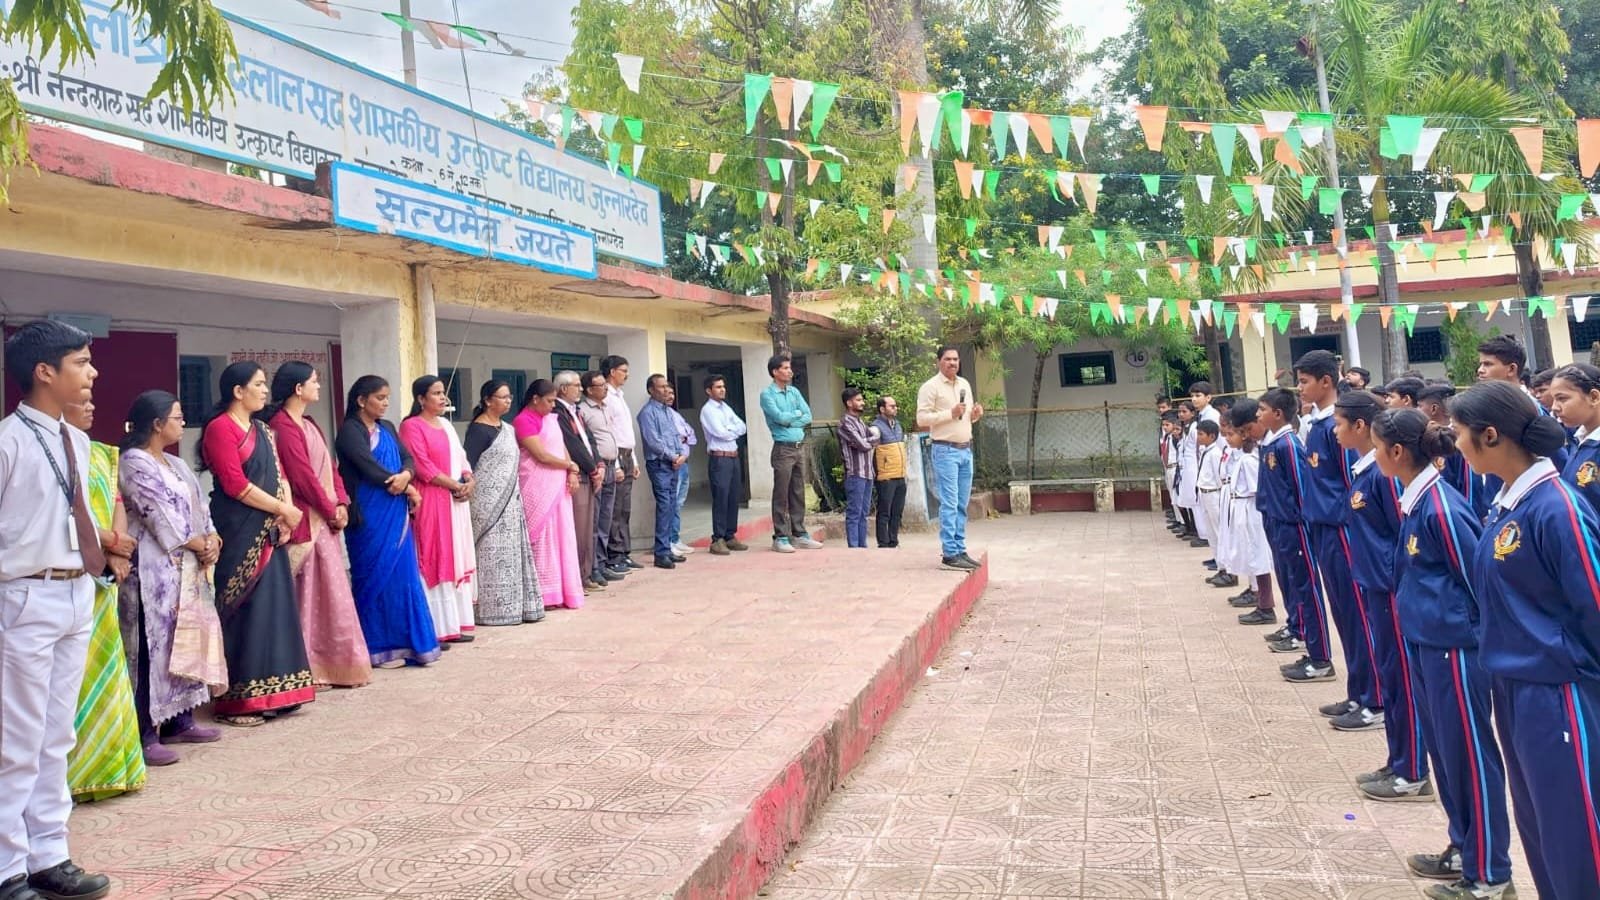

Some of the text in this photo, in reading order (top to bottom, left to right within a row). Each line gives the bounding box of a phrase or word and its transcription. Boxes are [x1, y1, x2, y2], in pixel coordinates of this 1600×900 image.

[13, 56, 41, 97] श्री
[46, 71, 122, 115] नन्दलाल
[235, 123, 284, 161] उत्कृष्ट
[306, 79, 344, 130] सूद
[348, 92, 441, 158] शासकीय
[446, 130, 513, 180] उत्कृष्ट
[515, 147, 586, 207] विद्यालय
[589, 182, 649, 226] जुन्नारदेव
[439, 168, 446, 181] 6
[459, 174, 469, 187] 12
[375, 187, 501, 246] सत्यमेव
[514, 225, 575, 263] जयते
[1129, 351, 1144, 363] 16
